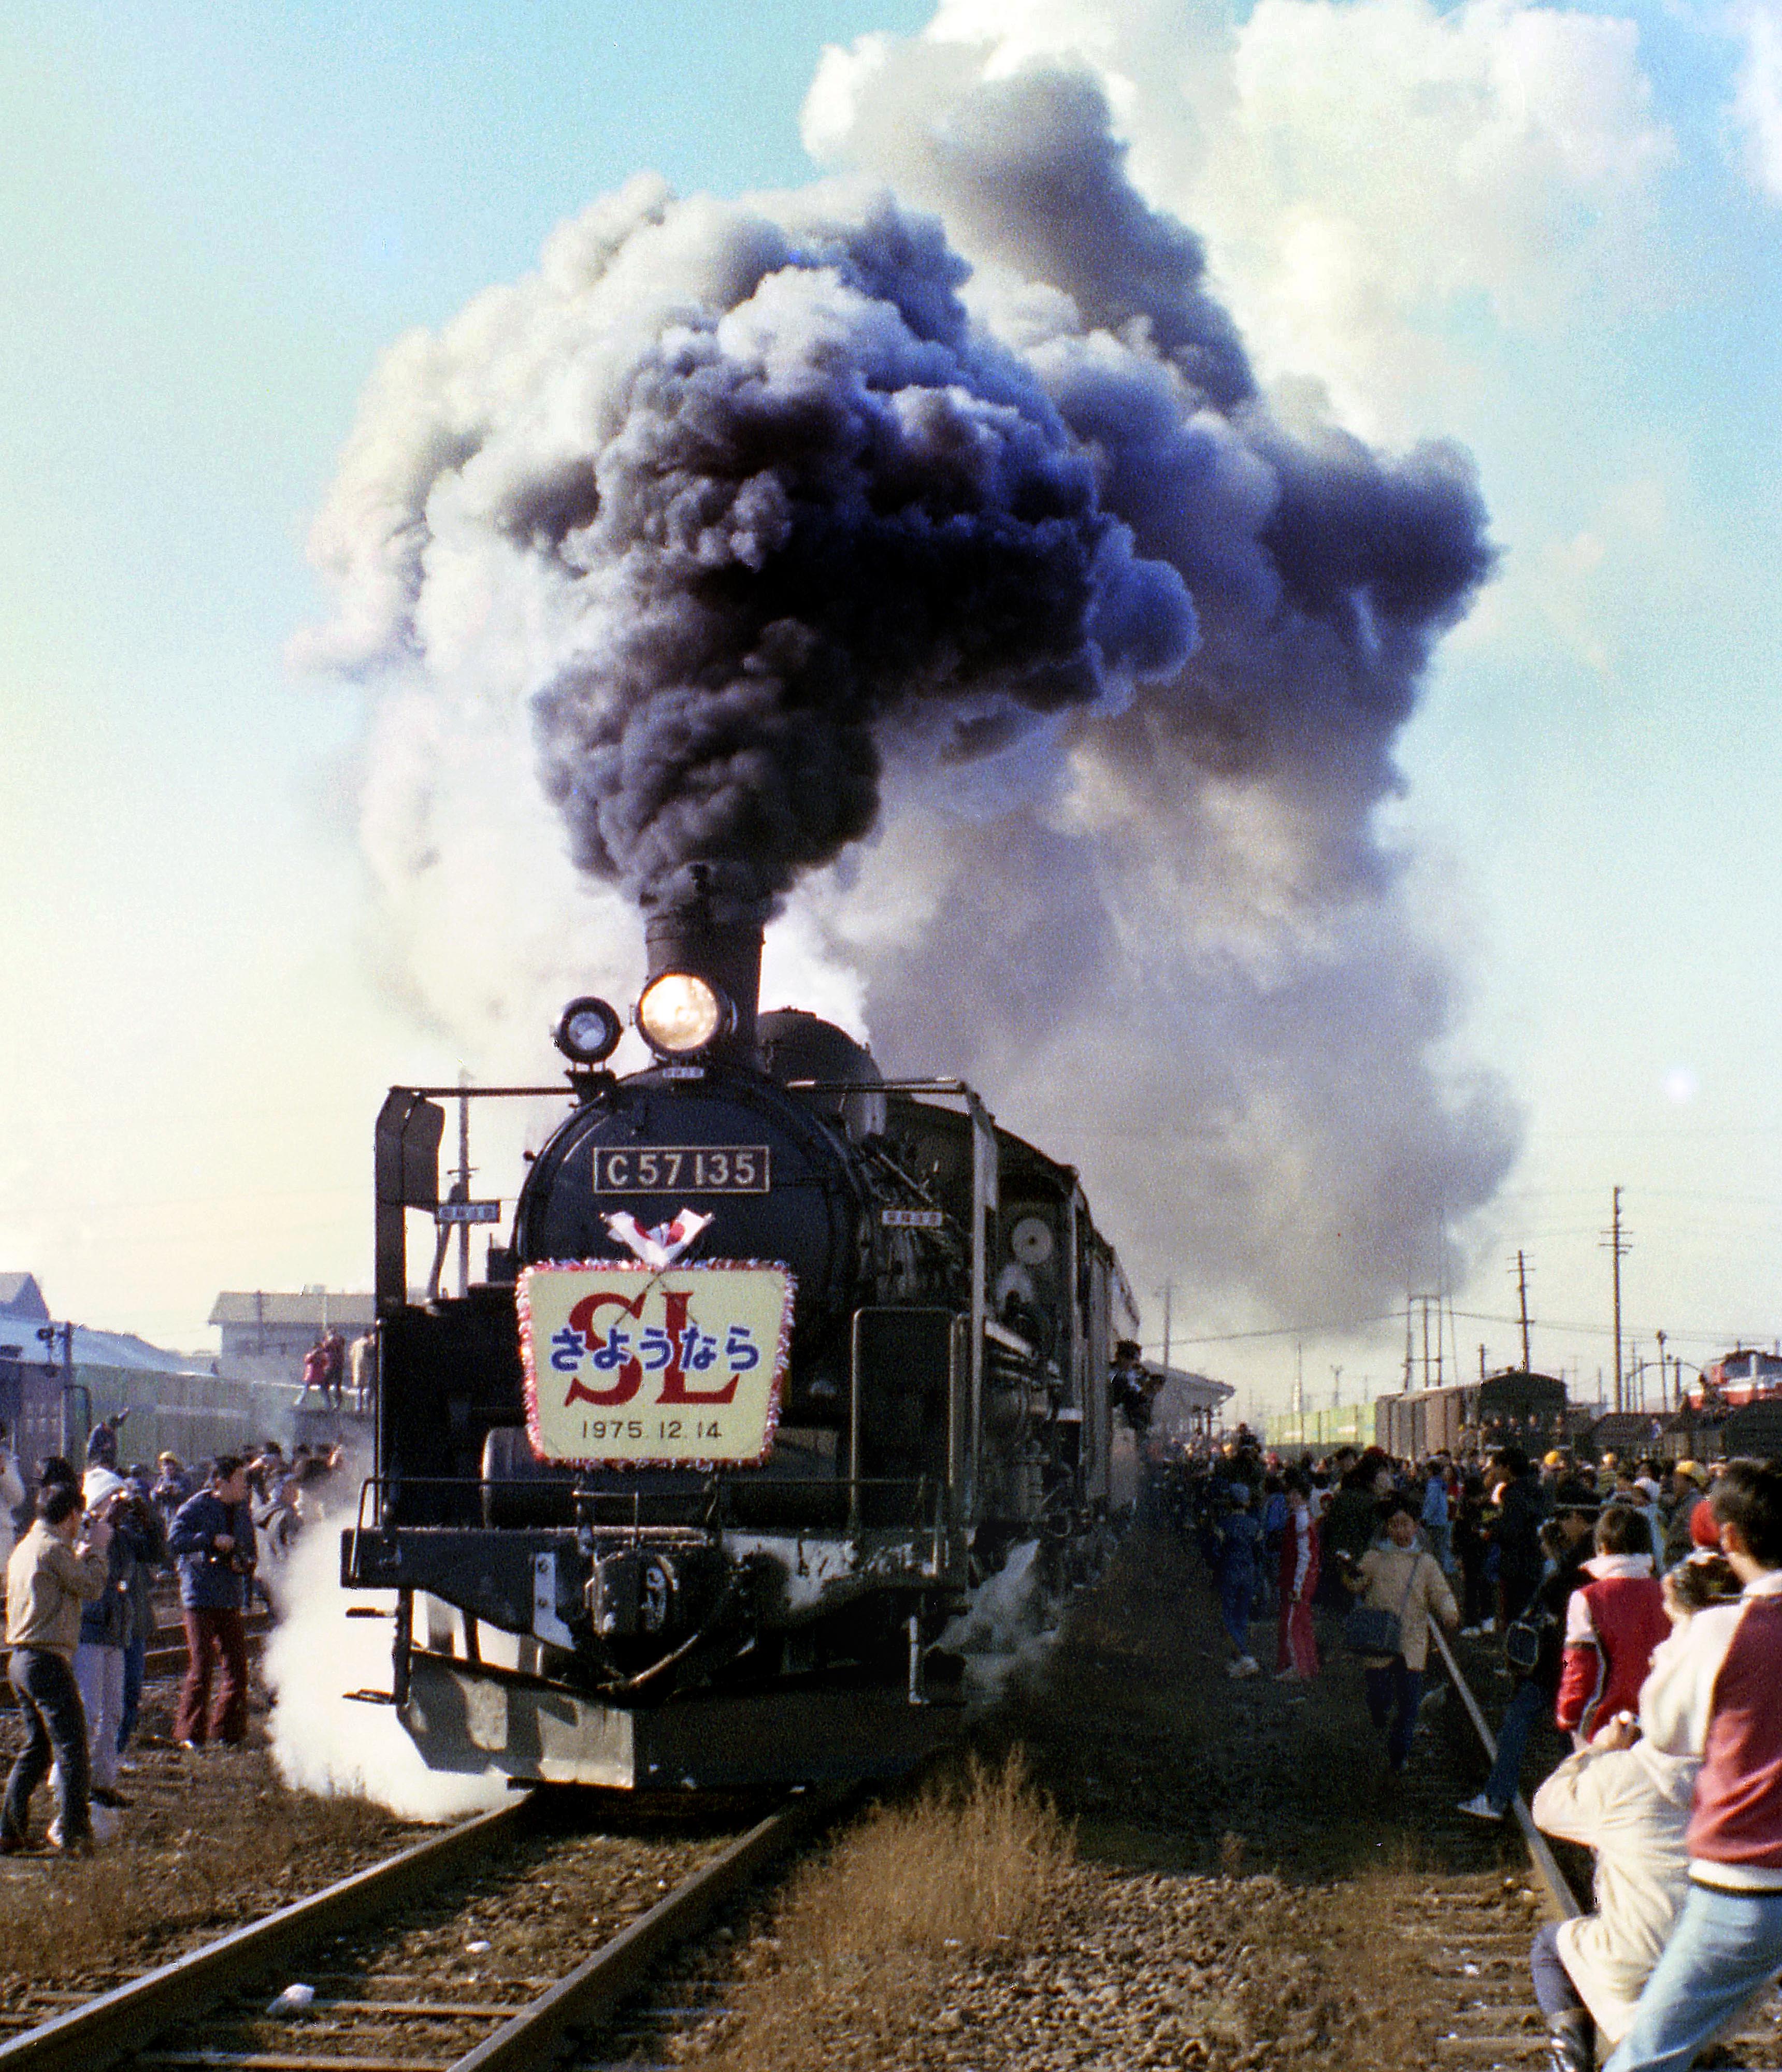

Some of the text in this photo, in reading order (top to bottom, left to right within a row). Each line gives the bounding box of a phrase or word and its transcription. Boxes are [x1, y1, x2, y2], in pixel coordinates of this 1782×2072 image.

[695, 1154, 755, 1185] 135
[550, 1325, 760, 1372] さようなら
[564, 1291, 740, 1407] SL
